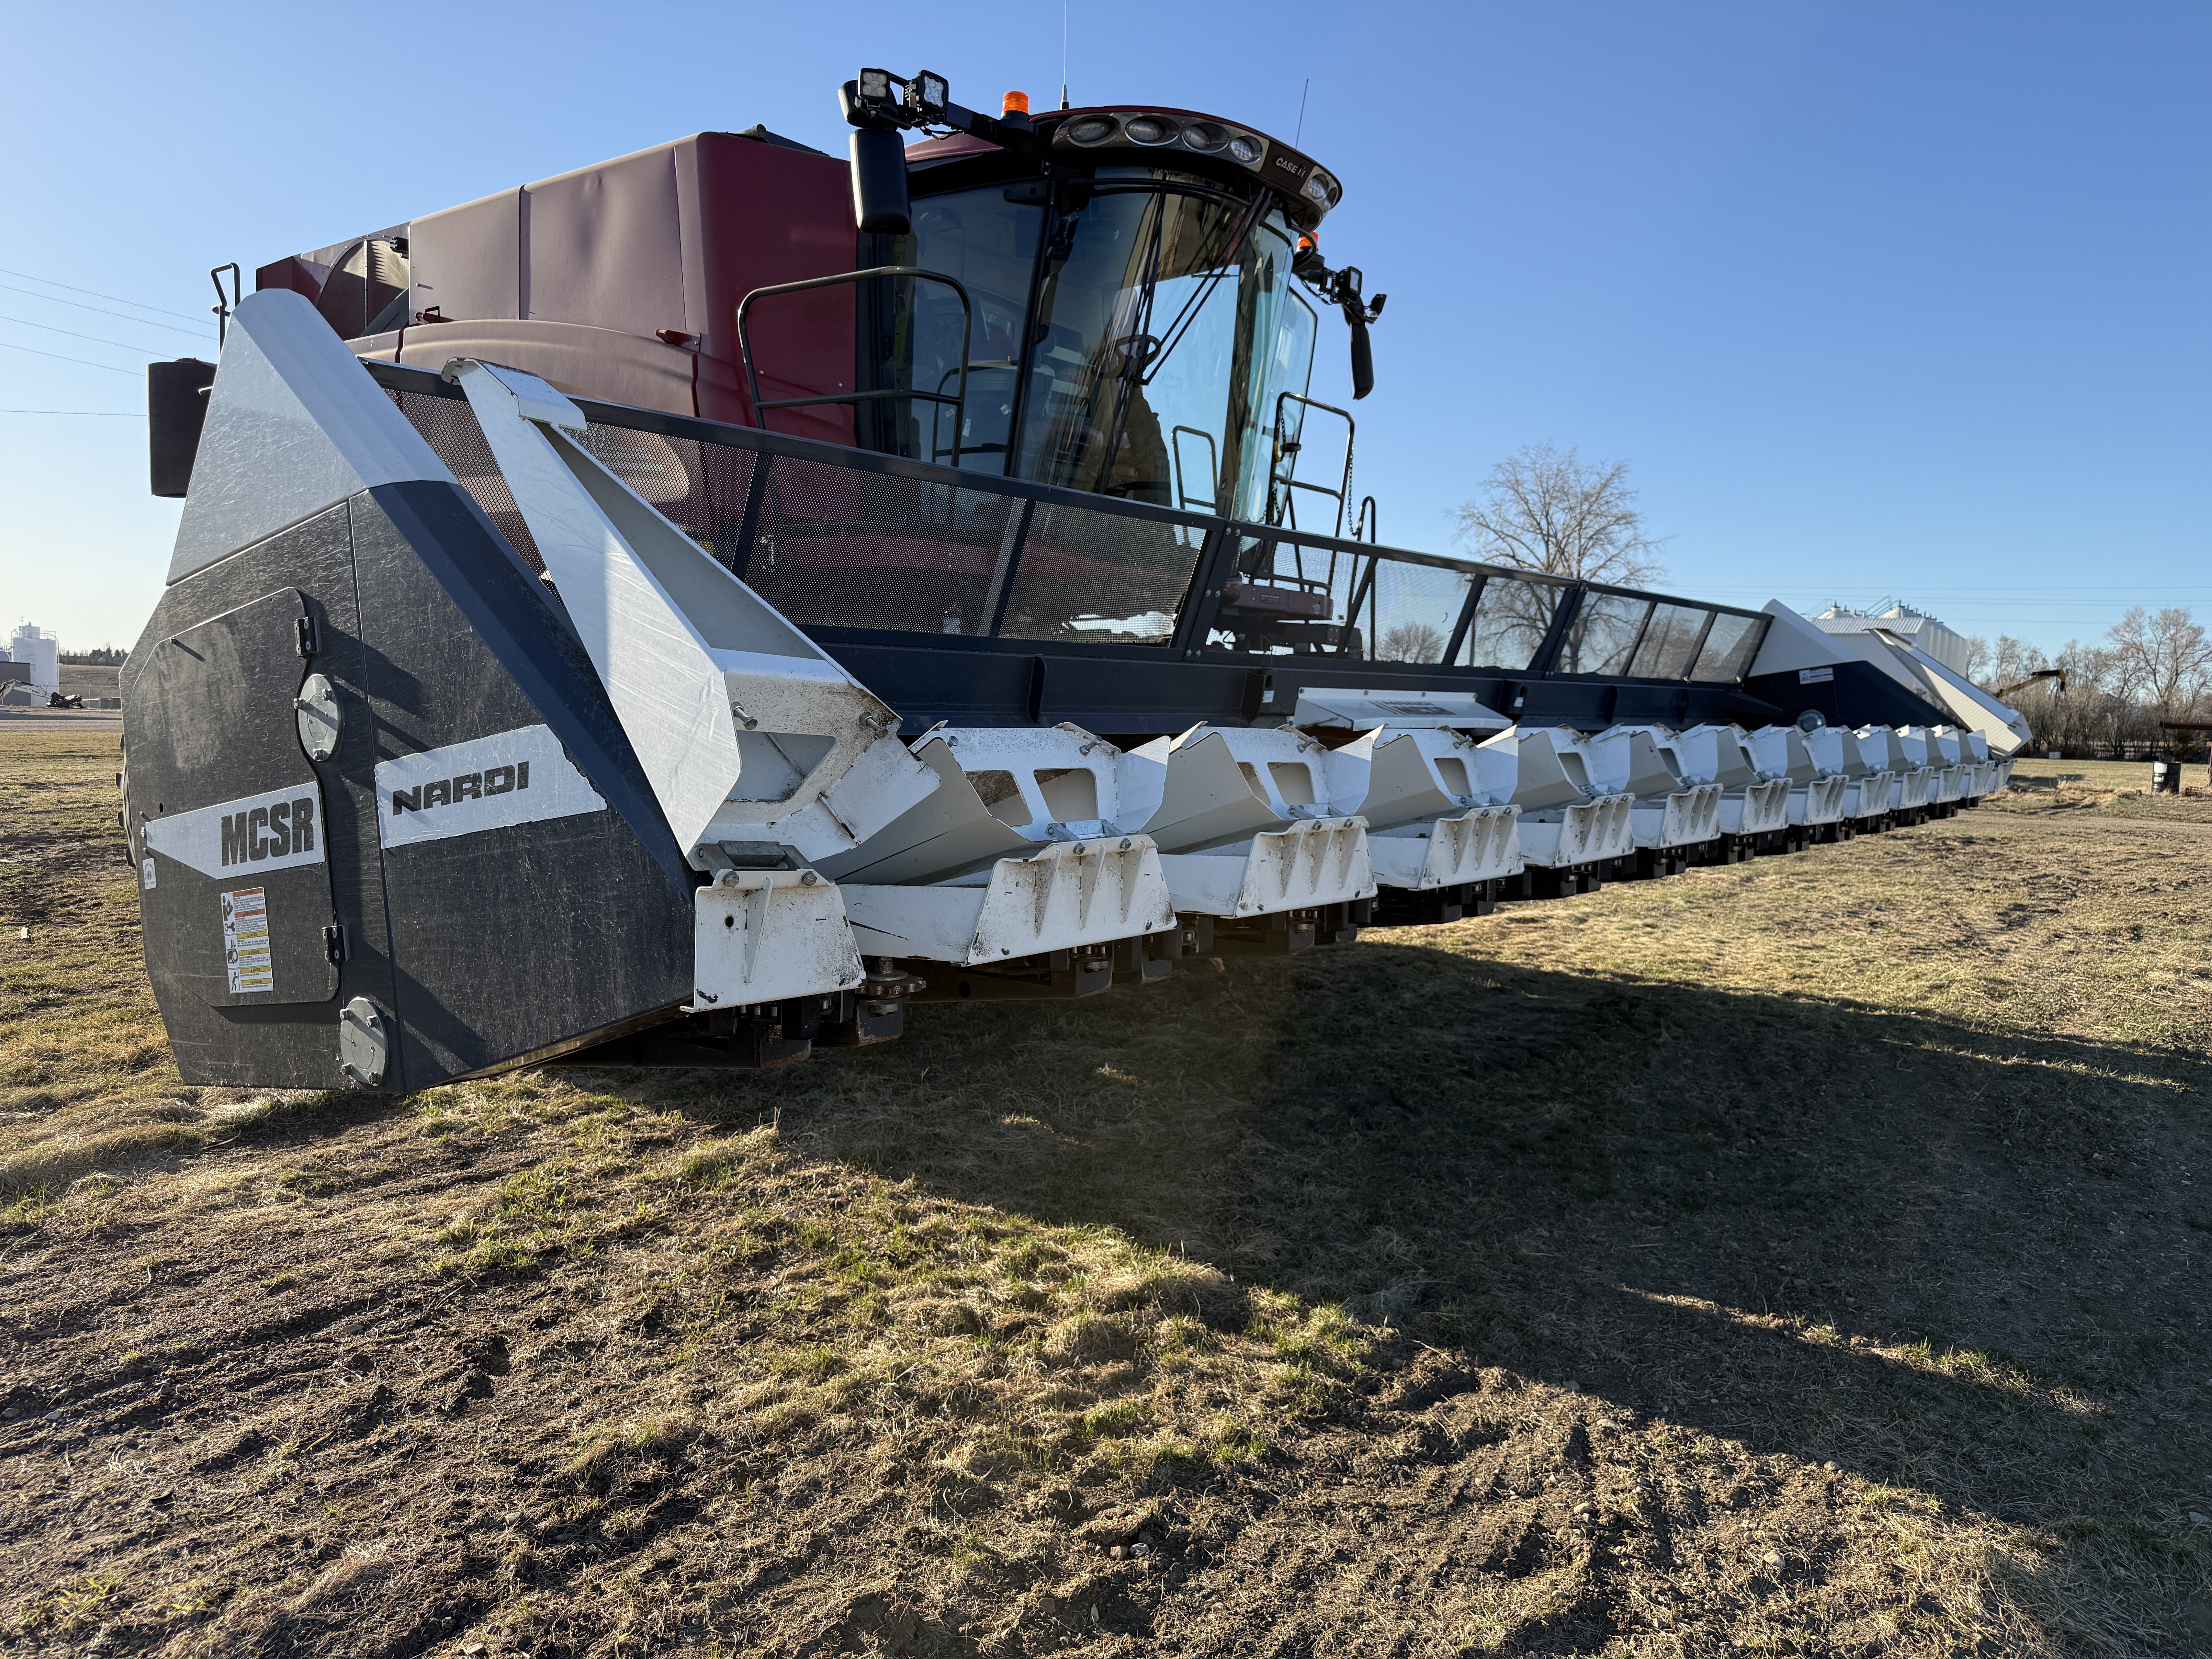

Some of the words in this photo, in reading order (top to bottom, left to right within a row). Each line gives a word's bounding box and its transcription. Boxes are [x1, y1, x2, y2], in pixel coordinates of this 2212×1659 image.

[1276, 158, 1298, 173] CASE
[393, 761, 529, 816] NARDI
[221, 797, 314, 867] MCSR
